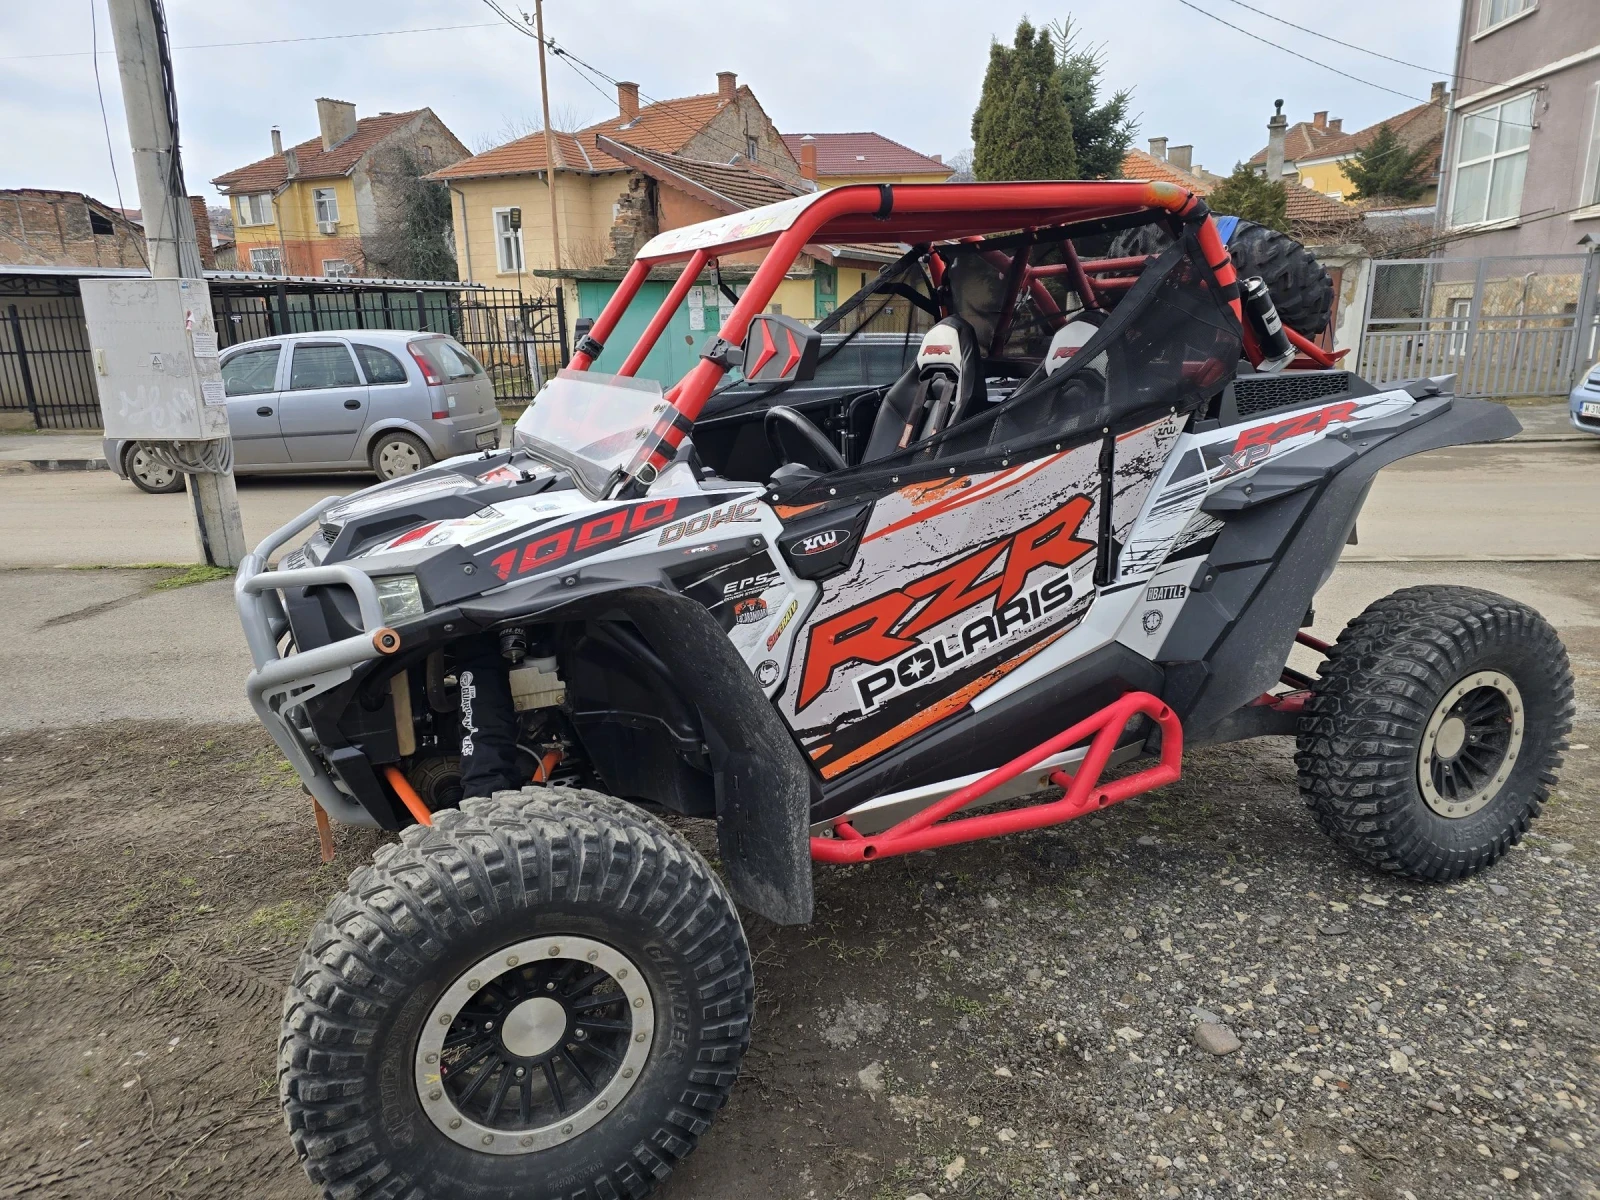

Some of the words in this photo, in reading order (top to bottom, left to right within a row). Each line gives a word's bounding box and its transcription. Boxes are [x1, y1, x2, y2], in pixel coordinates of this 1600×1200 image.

[1233, 402, 1360, 453] RZR
[1212, 442, 1271, 479] XP
[490, 497, 679, 581] 1000
[658, 499, 760, 548] DOHC
[724, 573, 769, 594] EPS
[796, 495, 1098, 715] RZR
[1152, 585, 1184, 600] BATTLE
[857, 571, 1074, 710] POLARIS
[645, 944, 690, 1063] CLIMBER
